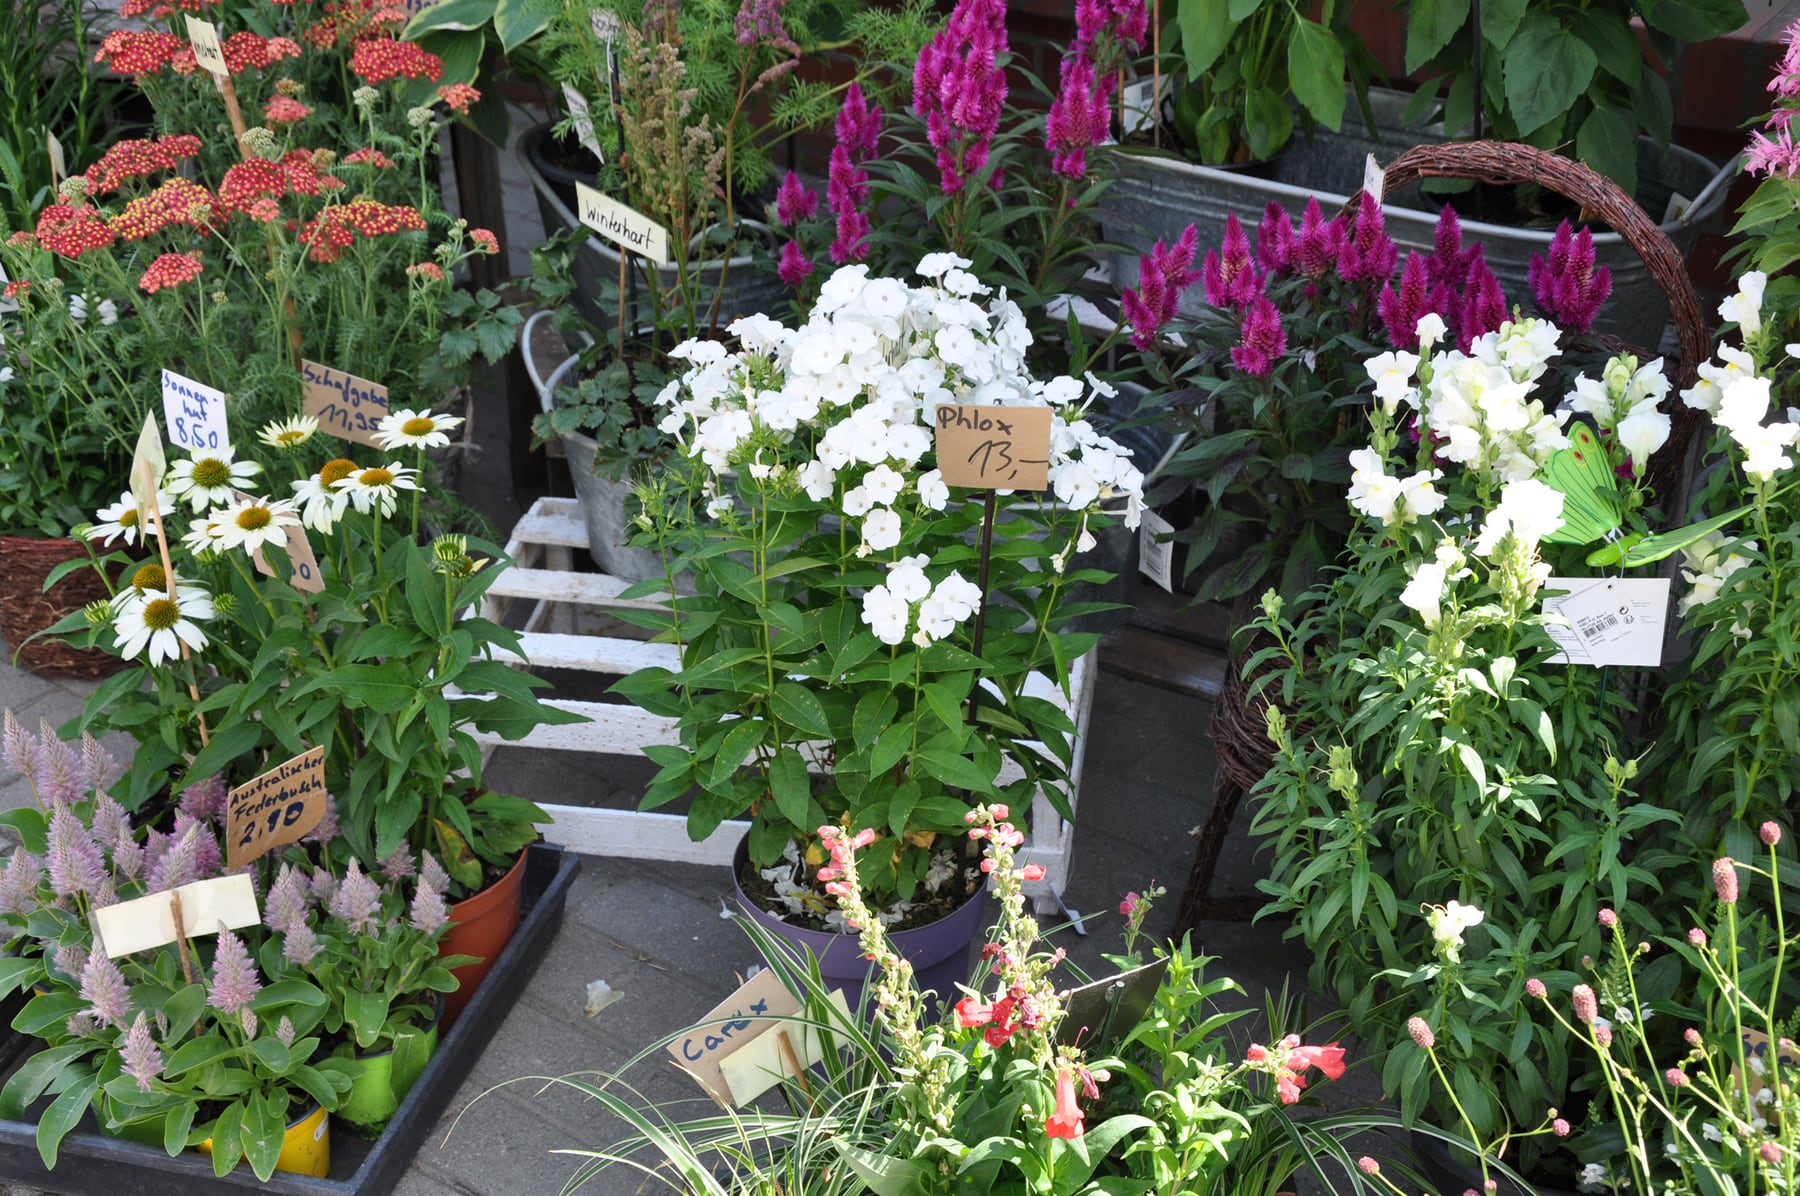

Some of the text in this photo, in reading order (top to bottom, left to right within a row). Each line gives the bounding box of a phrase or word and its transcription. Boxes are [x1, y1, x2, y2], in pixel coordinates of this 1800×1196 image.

[182, 399, 208, 422] hut
[317, 403, 384, 433] 11,95
[936, 406, 1014, 436] Phlox
[175, 416, 219, 450] 8,50
[229, 755, 324, 809] Australischer
[234, 773, 322, 823] Federbusch
[238, 801, 305, 848] 2,90
